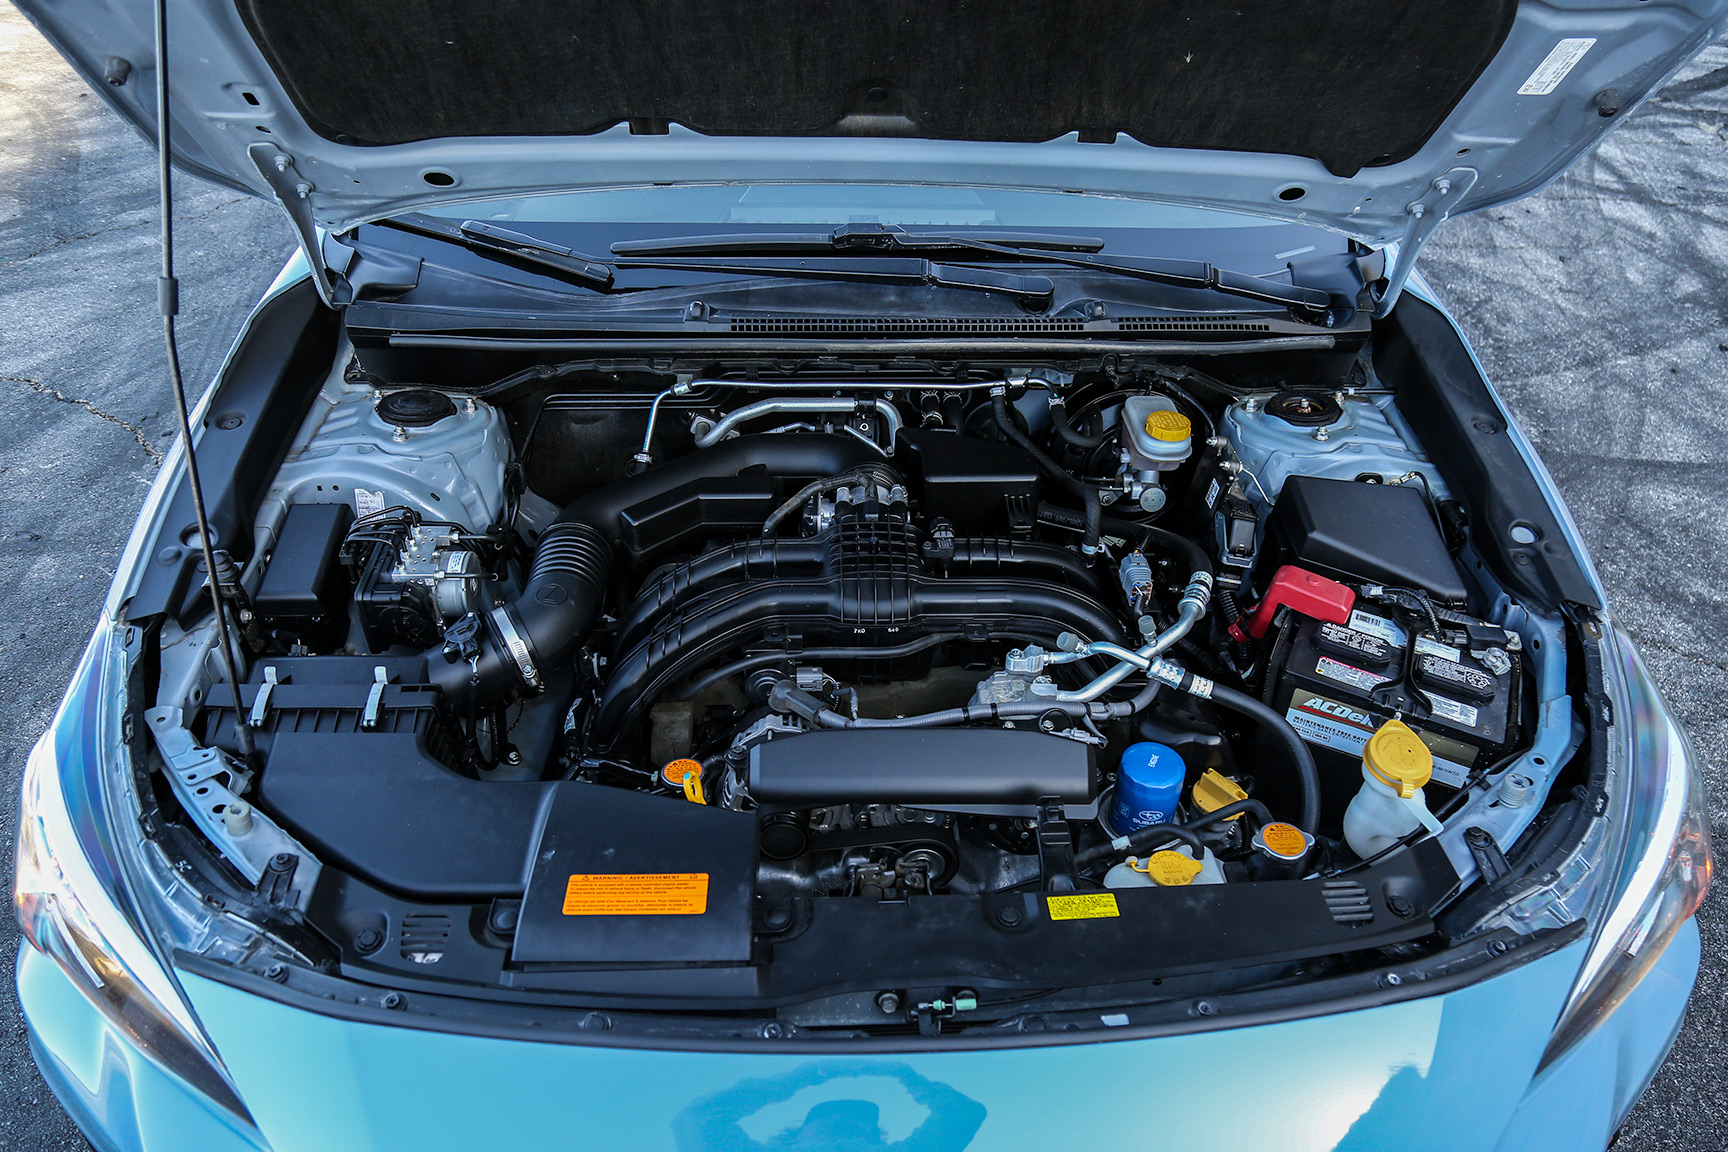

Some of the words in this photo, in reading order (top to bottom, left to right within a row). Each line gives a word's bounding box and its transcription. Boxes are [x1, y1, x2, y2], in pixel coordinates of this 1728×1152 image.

[1294, 715, 1336, 732] MAINTENANCE
[1337, 729, 1351, 738] FREE
[1352, 734, 1368, 743] BATT
[1132, 817, 1166, 825] SUBARU
